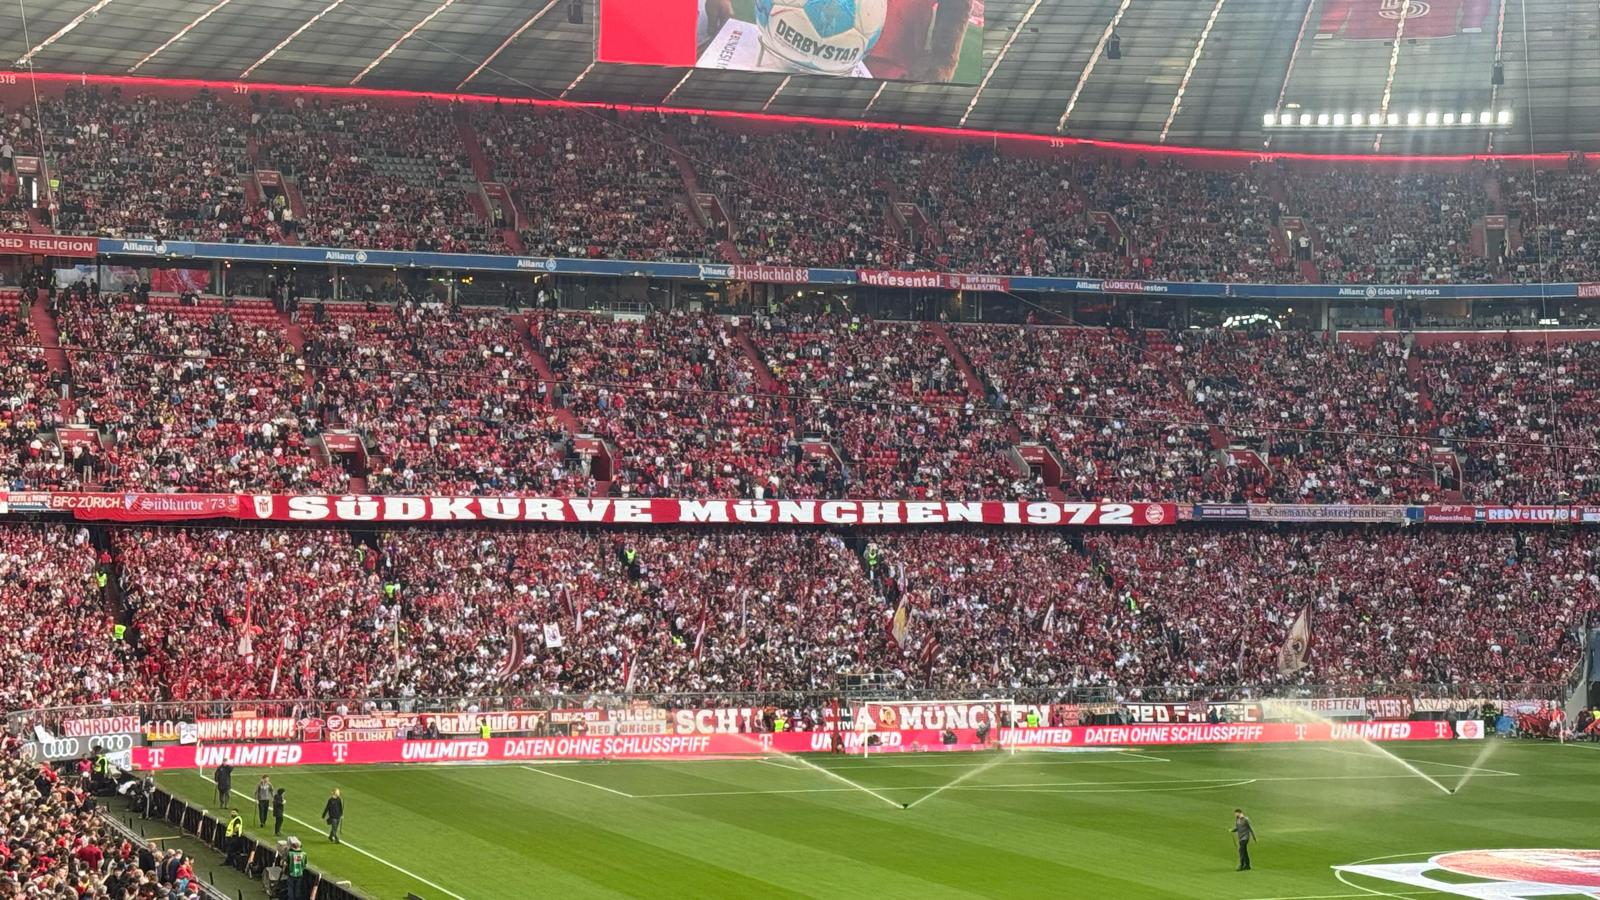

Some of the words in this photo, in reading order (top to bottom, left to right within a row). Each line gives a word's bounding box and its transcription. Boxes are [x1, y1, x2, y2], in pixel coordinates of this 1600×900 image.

[775, 18, 860, 62] DERBYSTAR
[0, 74, 16, 85] 318
[233, 84, 249, 94] 317
[29, 240, 94, 254] RELIGION
[122, 242, 154, 252] Allianz
[325, 251, 355, 261] Allianz
[517, 259, 545, 269] Allianz
[737, 266, 794, 282] Haslachtal
[795, 266, 809, 282] 83
[1076, 281, 1101, 291] Allianz
[1104, 280, 1144, 290] LÜDERTAL
[1338, 287, 1365, 296] Allianz
[1377, 287, 1403, 296] Global
[1404, 287, 1440, 297] Investors
[53, 495, 78, 507] BFC
[78, 495, 120, 509] ZÜRICH
[141, 496, 204, 511] Südkurve
[206, 498, 226, 510] '73
[288, 496, 652, 522] SÜDKURVE
[678, 499, 983, 524] MÜNCHEN
[1002, 502, 1134, 524] 1972
[1311, 698, 1361, 711] BRETTEN
[1366, 699, 1401, 718] SELTERS
[64, 716, 141, 736] ROHRDORF
[1330, 722, 1412, 740] UNLIMITED
[330, 731, 352, 742] RED
[356, 731, 394, 741] COBRA
[999, 728, 1072, 746] UNLIMITED
[1084, 727, 1130, 744] DATEN
[1131, 727, 1169, 743] OHNE
[1170, 725, 1264, 743] SCHLUSSPFIFF
[402, 740, 489, 760] UNLIMITED
[503, 739, 556, 757] DATEN
[557, 738, 602, 756] OHNE
[603, 735, 711, 755] SCHLUSSPFIFF
[194, 745, 303, 767] UNLIMITED
